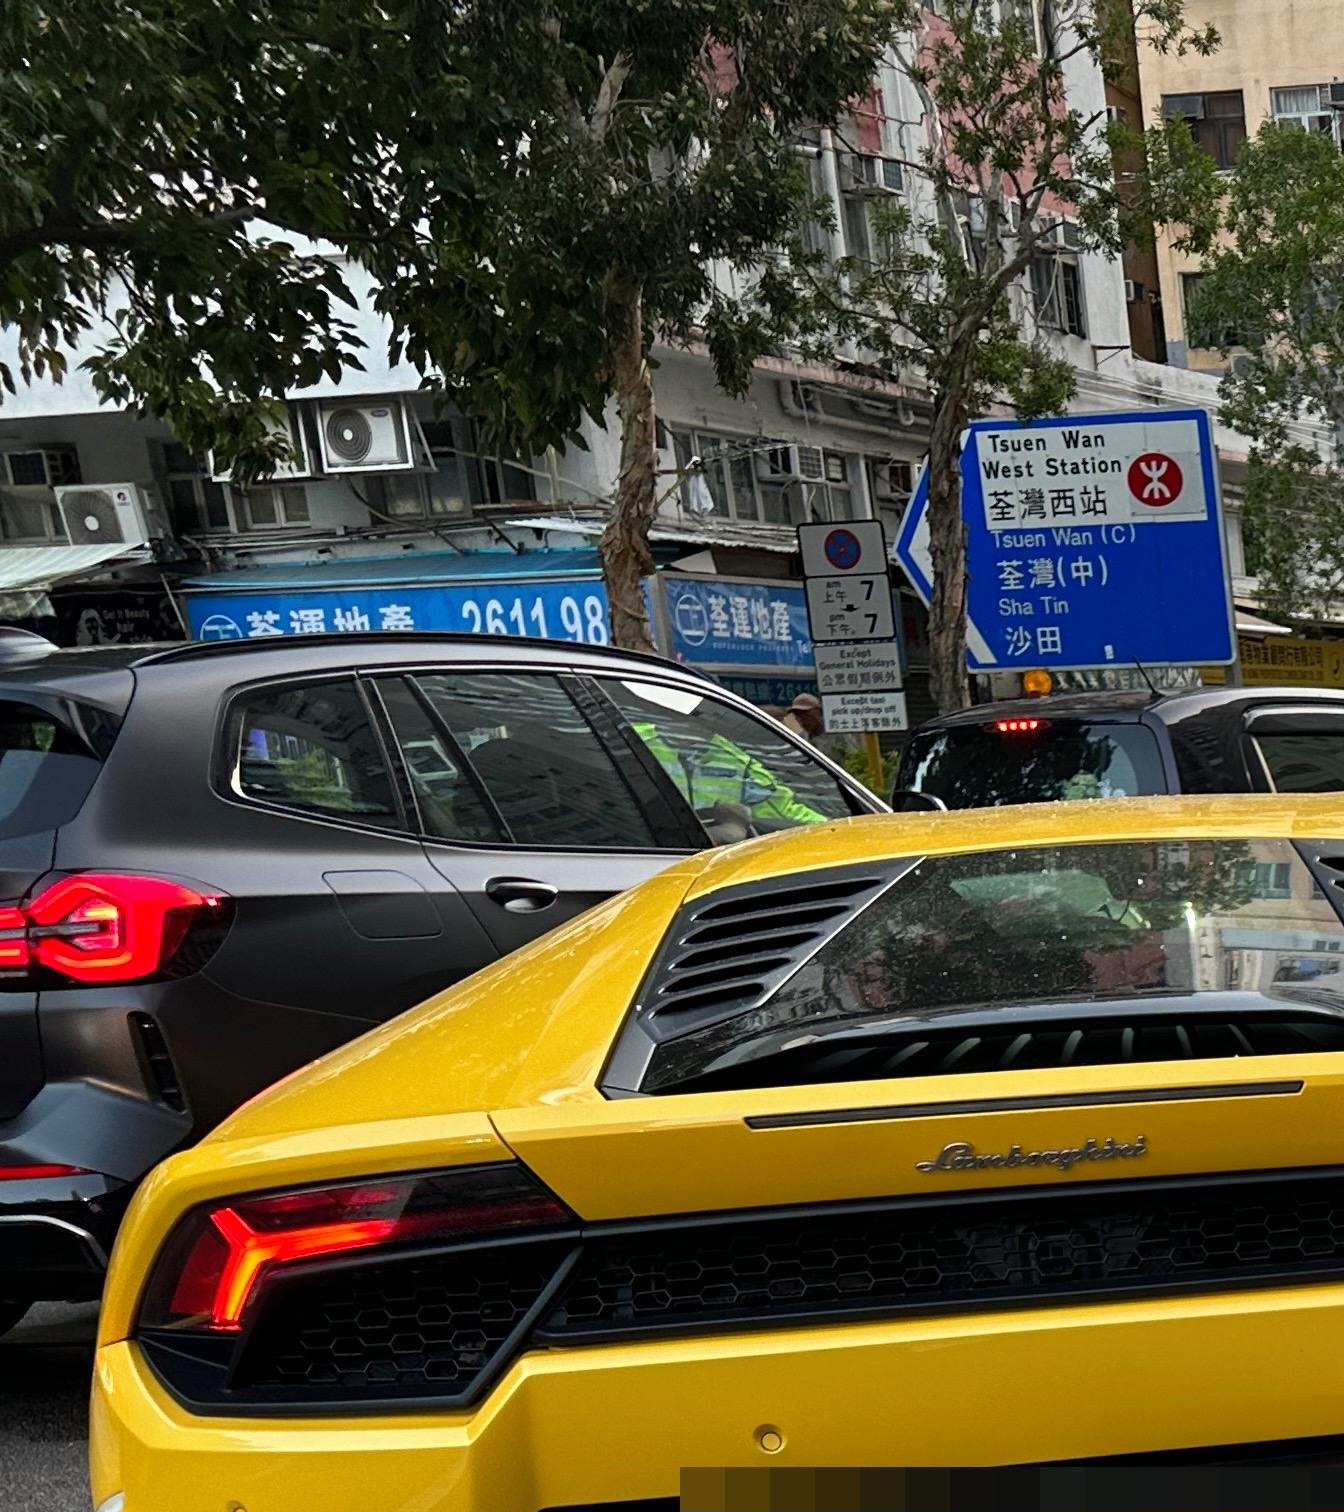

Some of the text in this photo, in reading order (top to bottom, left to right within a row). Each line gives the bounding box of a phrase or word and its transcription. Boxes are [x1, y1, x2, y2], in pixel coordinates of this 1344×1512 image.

[988, 430, 1105, 453] Tsuen Wan
[982, 457, 1122, 479] West Station
[988, 485, 1108, 521] 荃灣西站
[990, 523, 1136, 548] Tsuen Wan (C)
[997, 555, 1108, 590] 荃灣(中)
[826, 581, 841, 589] am
[860, 580, 874, 600] 7
[824, 591, 847, 603] 上午
[999, 596, 1069, 616] Sha Tin
[462, 598, 548, 638] 2611
[707, 594, 792, 641] 荃運地產
[829, 614, 845, 623] pm
[864, 613, 878, 634] 7
[1005, 626, 1062, 656] 沙田
[840, 648, 871, 659] Except
[819, 659, 896, 671] General Holidays
[841, 695, 886, 705] Except taxi
[884, 705, 896, 714] off
[916, 1135, 1146, 1172] Lamborghini
